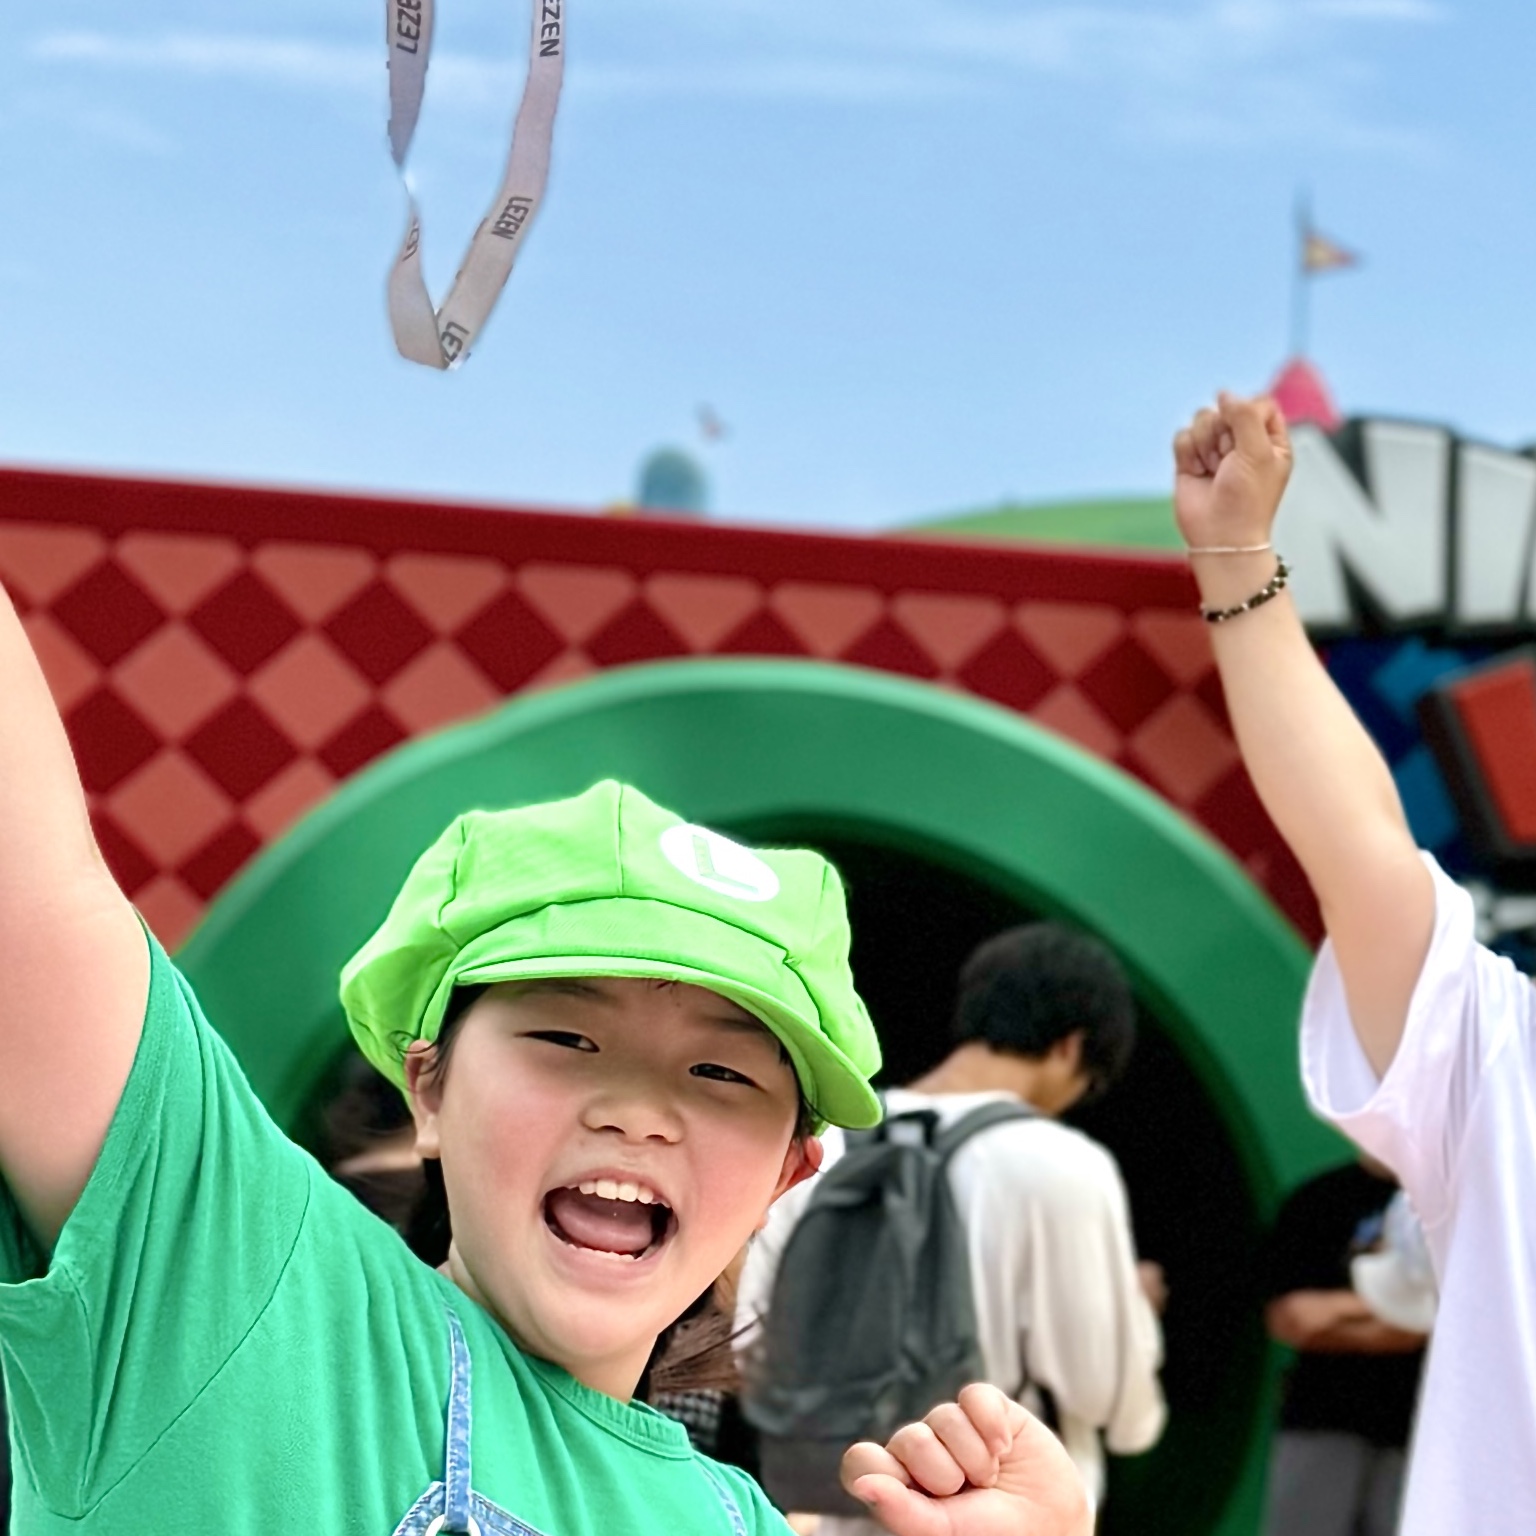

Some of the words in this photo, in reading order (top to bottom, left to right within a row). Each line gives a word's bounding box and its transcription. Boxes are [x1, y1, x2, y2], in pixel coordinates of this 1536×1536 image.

[539, 0, 561, 58] ZEN
[491, 195, 534, 240] LEZEN
[691, 833, 760, 896] L
